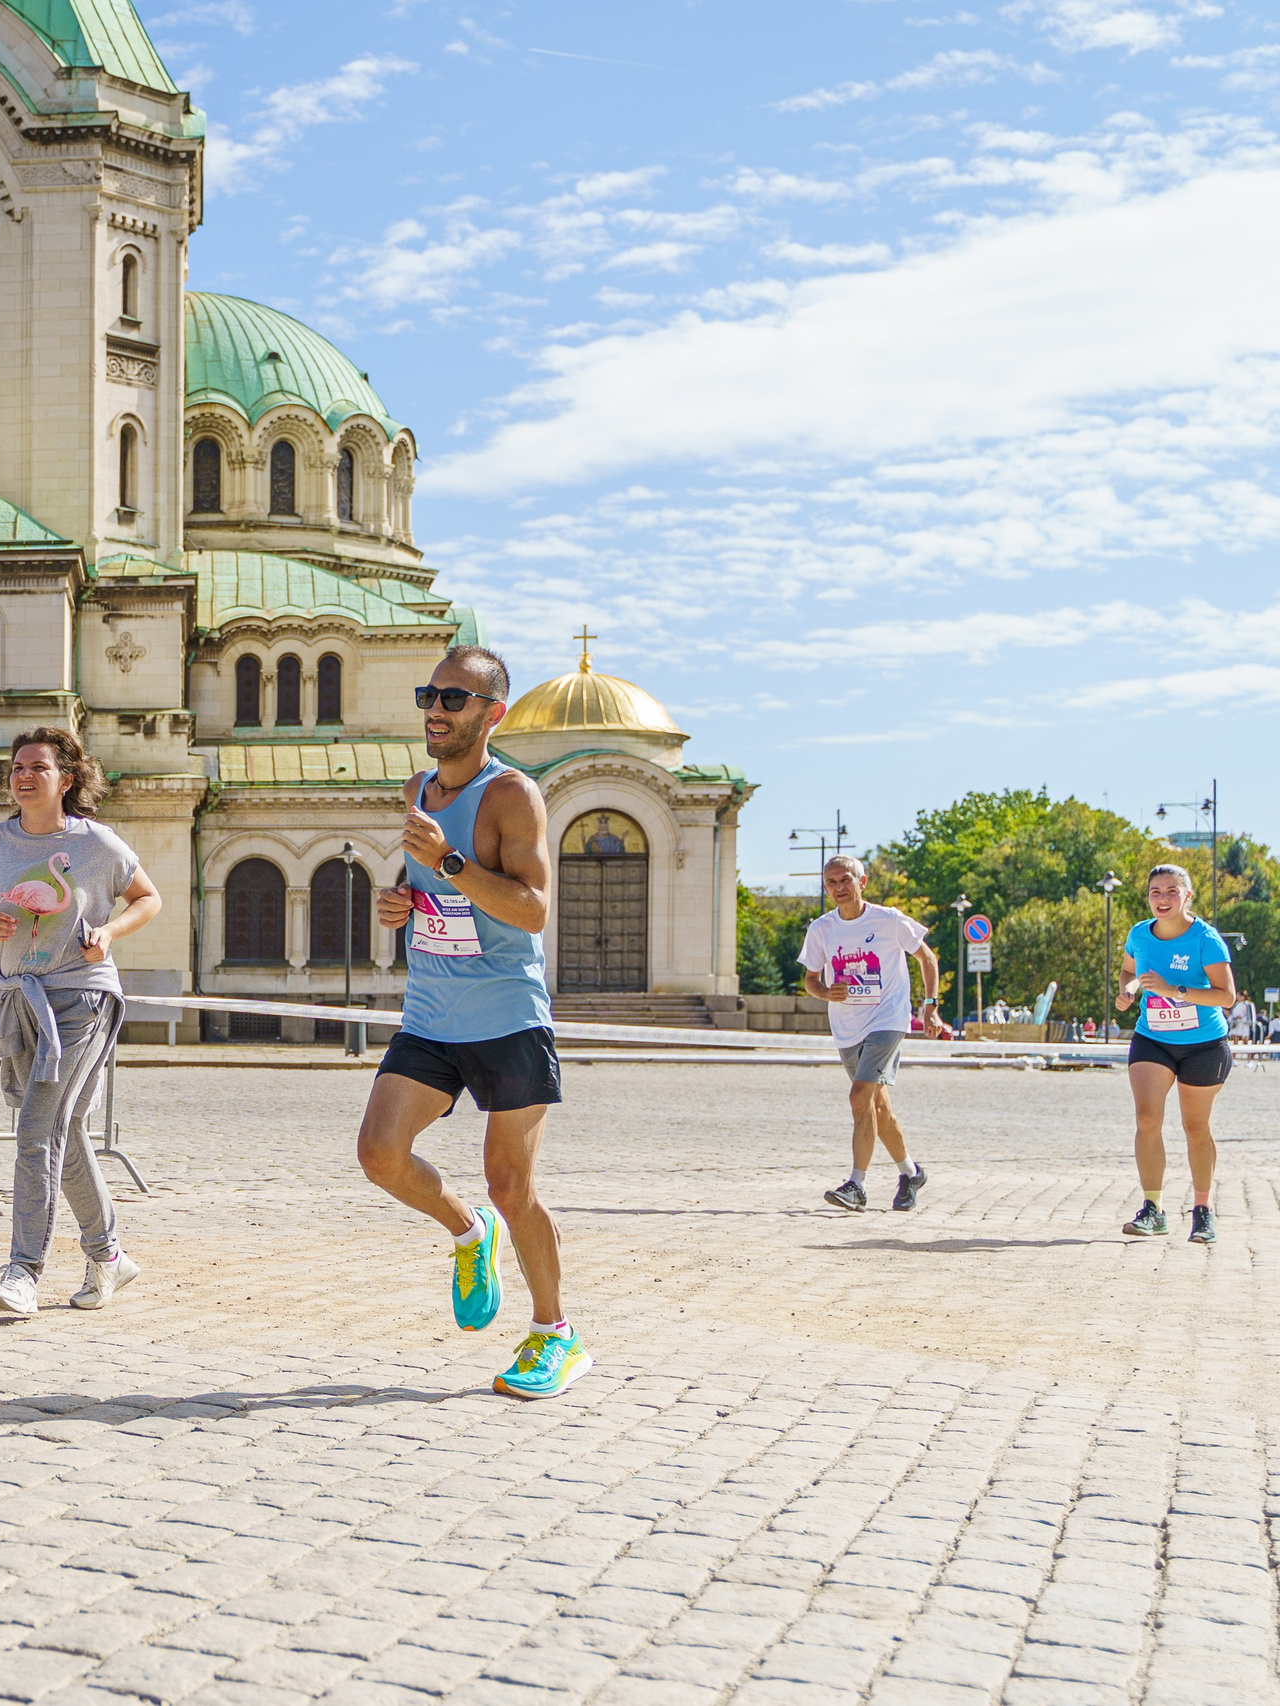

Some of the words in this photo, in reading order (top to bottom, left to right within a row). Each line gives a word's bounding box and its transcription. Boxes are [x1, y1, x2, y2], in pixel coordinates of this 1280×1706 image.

[427, 917, 448, 935] 82
[1169, 963, 1189, 971] BIRD
[1159, 1009, 1181, 1020] 618
